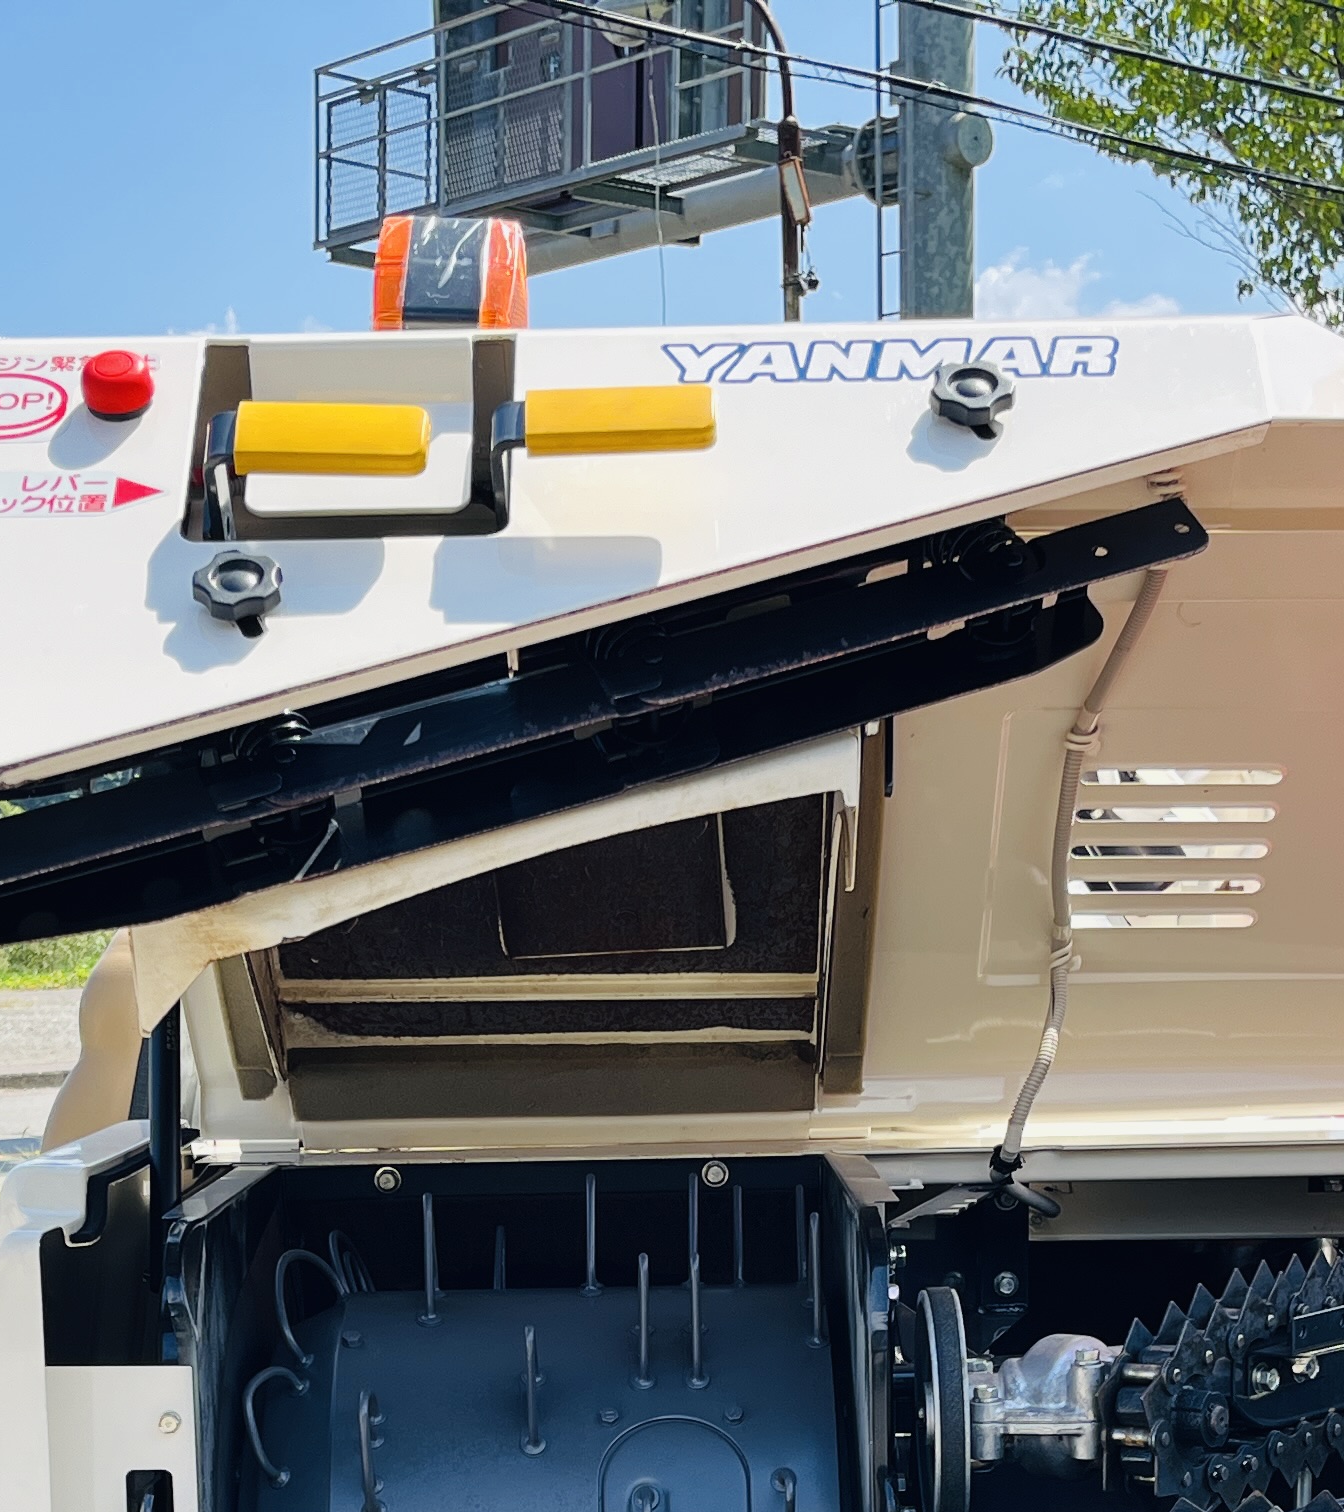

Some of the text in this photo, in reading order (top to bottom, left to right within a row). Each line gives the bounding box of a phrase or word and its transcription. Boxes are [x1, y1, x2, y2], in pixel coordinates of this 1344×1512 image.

[661, 336, 1119, 383] YANMAR
[22, 474, 108, 492] レバー
